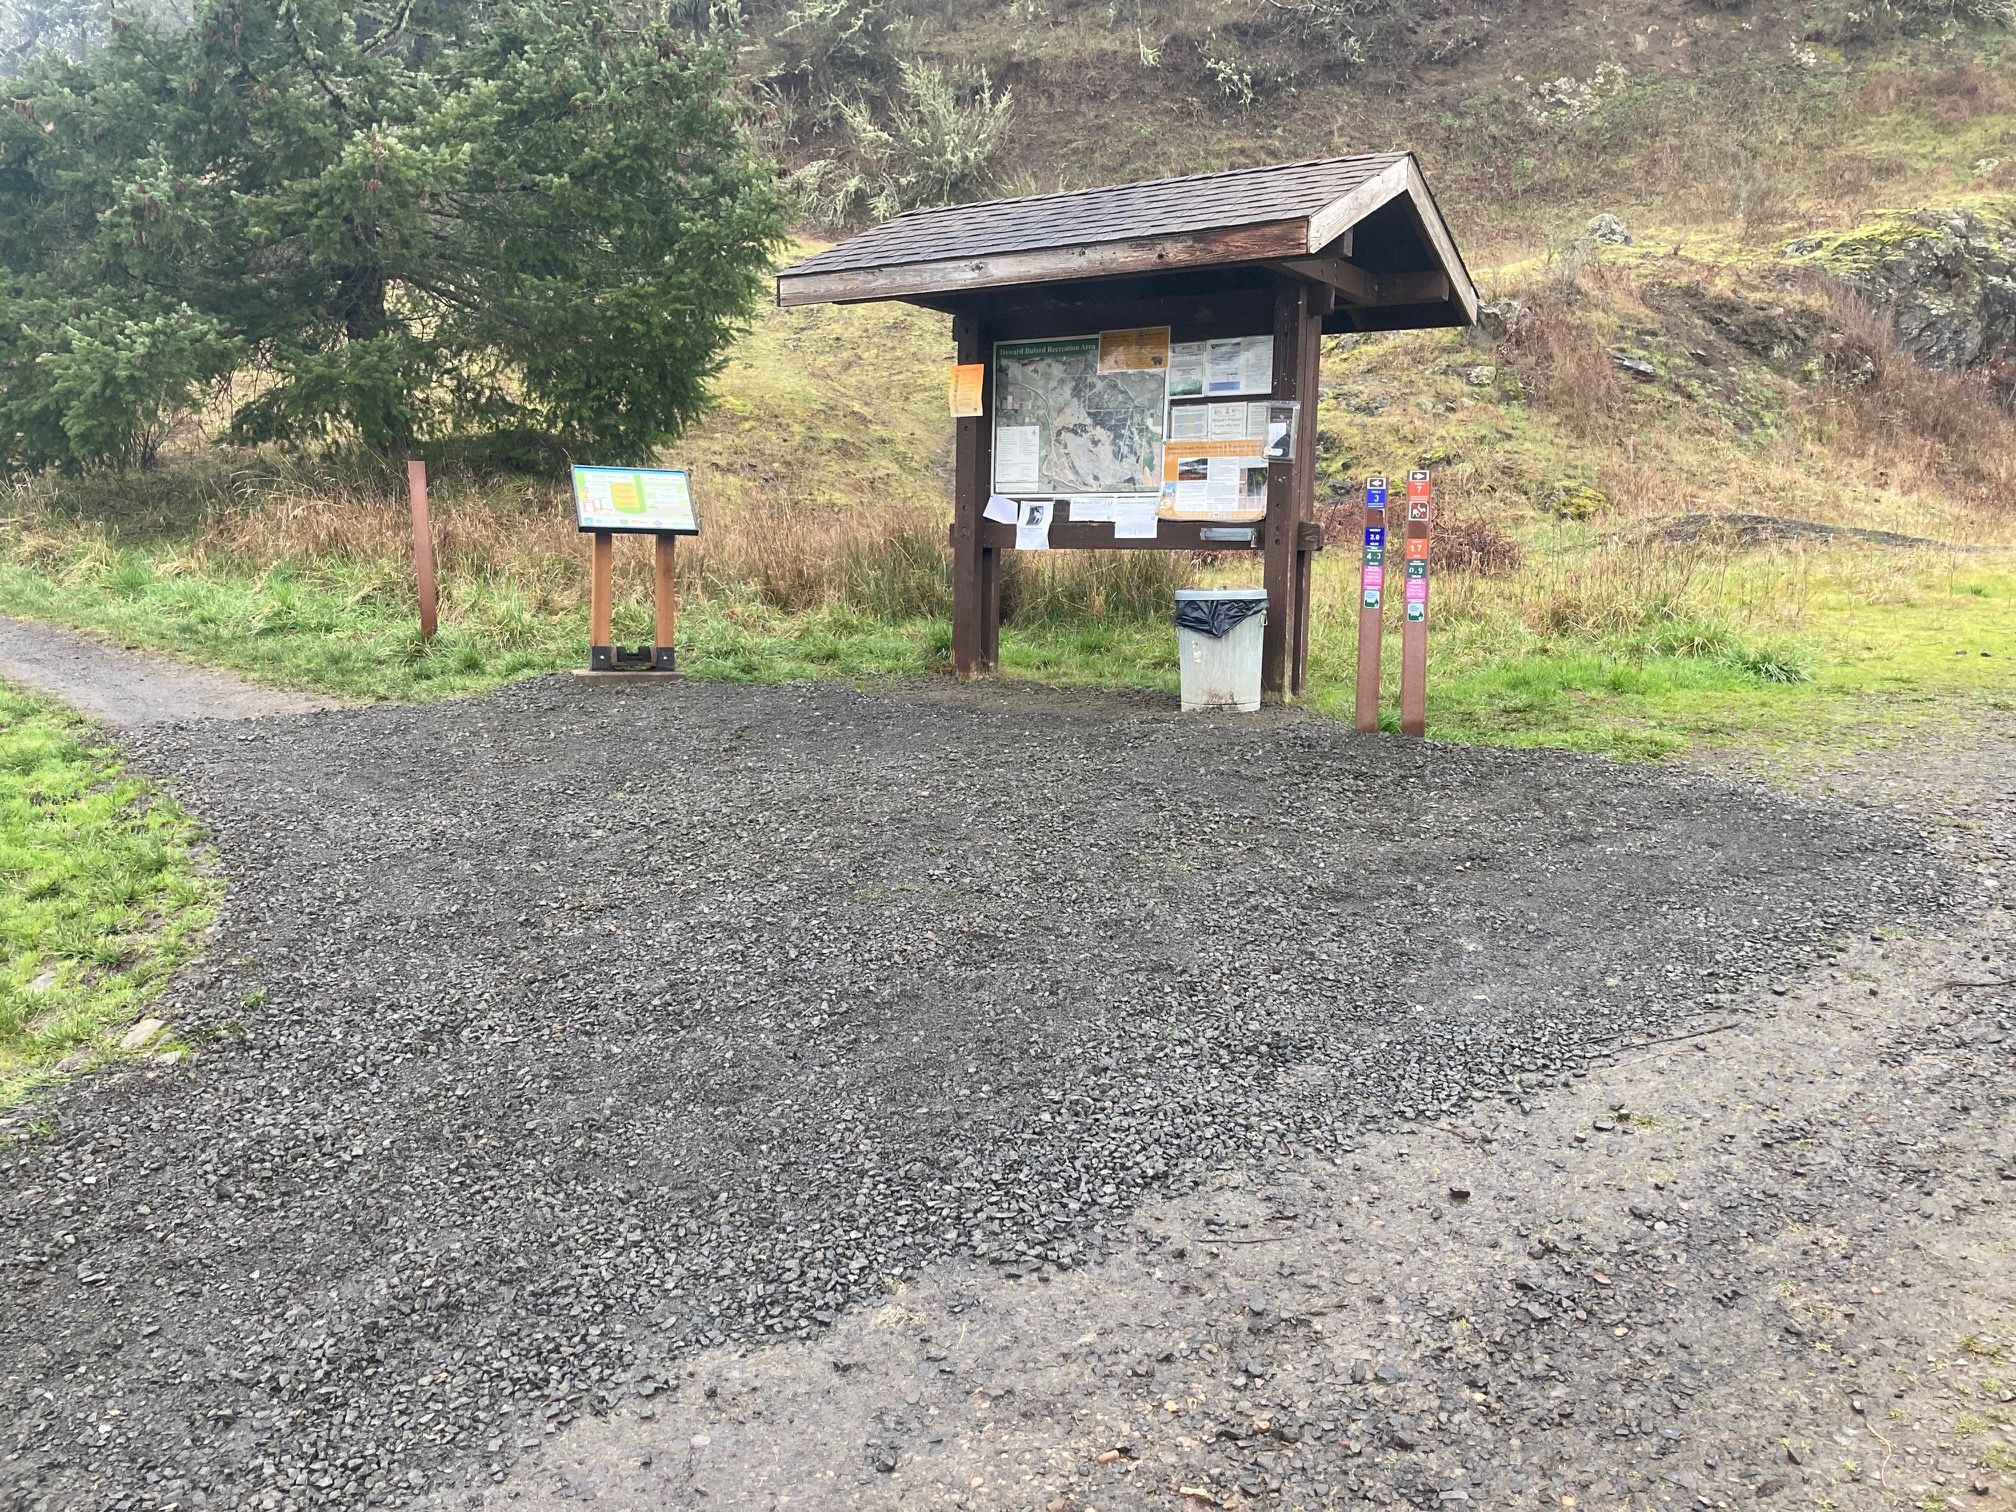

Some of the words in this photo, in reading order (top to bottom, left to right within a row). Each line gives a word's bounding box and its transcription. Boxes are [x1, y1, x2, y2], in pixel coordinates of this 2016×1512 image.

[1000, 348, 1024, 356] Howard
[1025, 346, 1046, 355] Buford
[1047, 345, 1079, 353] Recreation
[1080, 343, 1096, 351] Area
[1416, 486, 1422, 494] 7
[1373, 494, 1380, 503] 3
